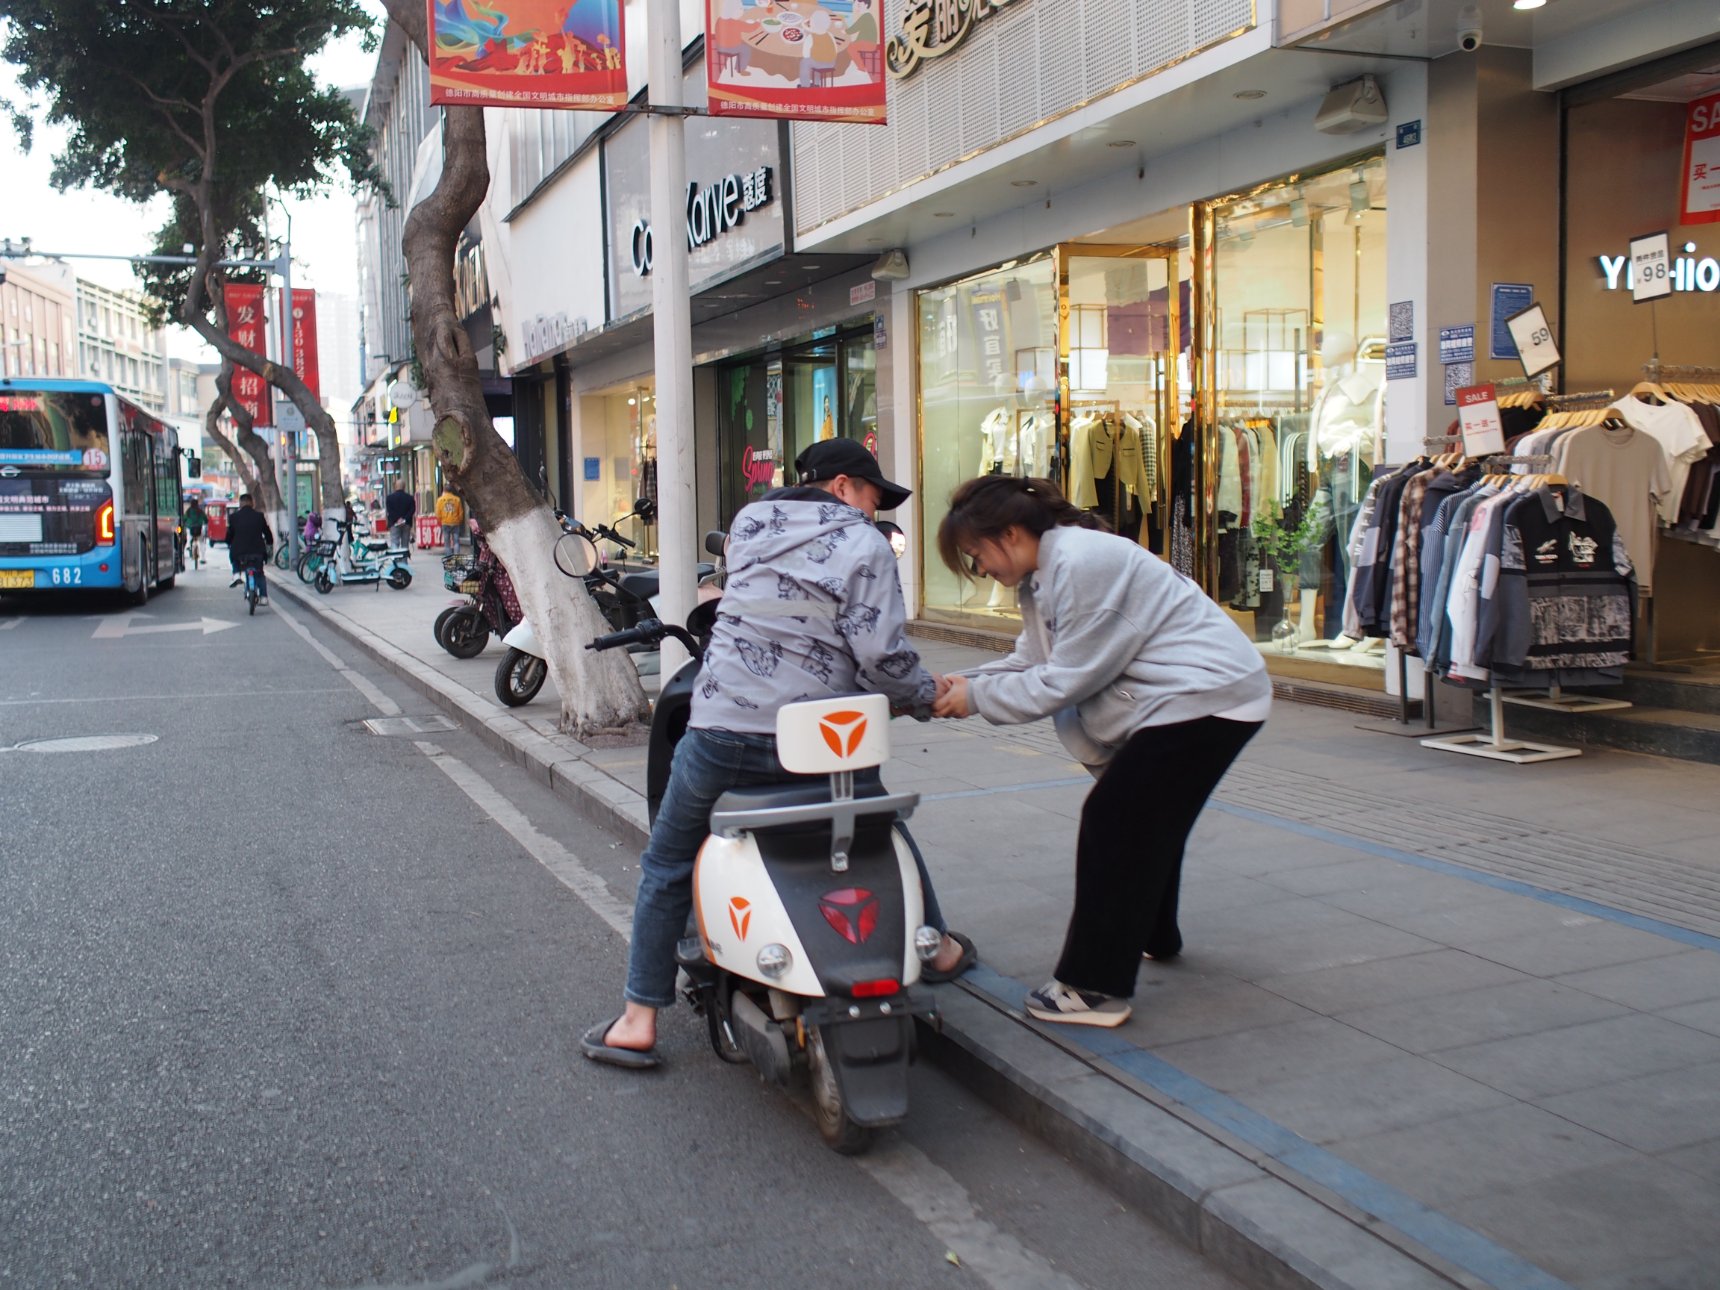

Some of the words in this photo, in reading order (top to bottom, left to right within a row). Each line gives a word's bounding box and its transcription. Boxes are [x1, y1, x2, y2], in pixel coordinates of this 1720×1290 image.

[1531, 327, 1550, 346] 59
[1465, 391, 1489, 404] SALE
[52, 567, 82, 584] 682
